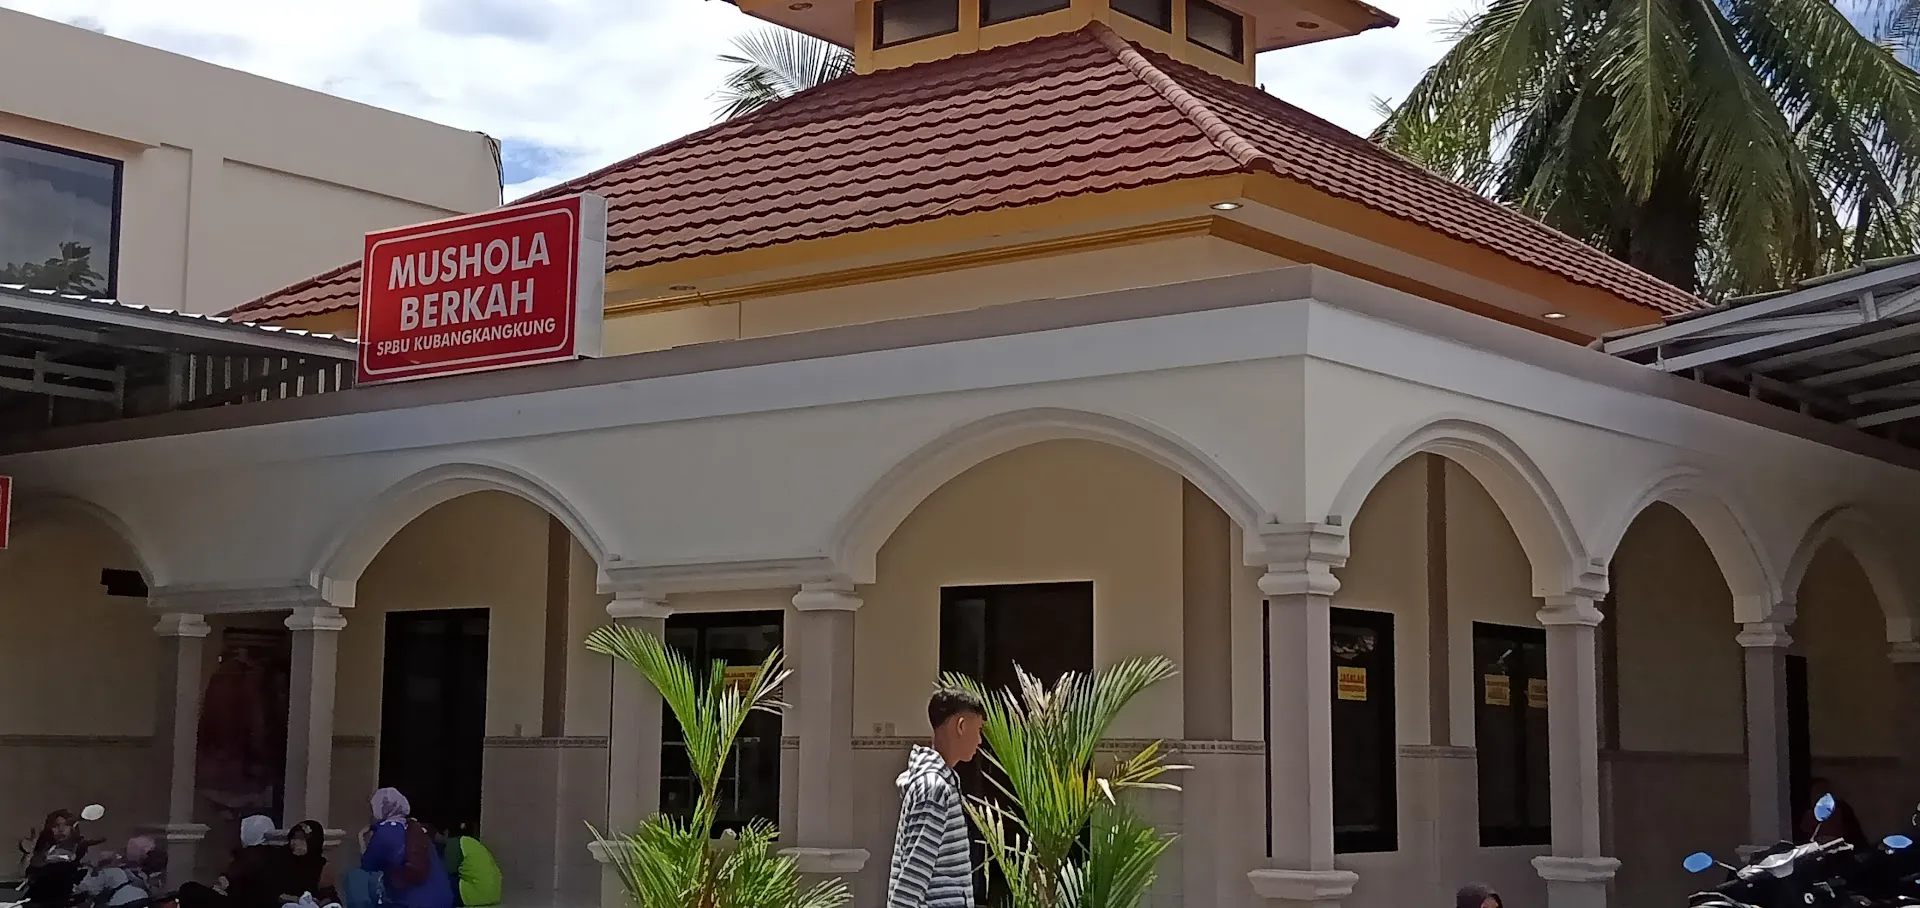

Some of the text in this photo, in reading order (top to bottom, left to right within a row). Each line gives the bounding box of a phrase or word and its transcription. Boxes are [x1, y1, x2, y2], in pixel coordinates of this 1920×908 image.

[388, 231, 550, 291] MUSHOLA
[400, 278, 535, 332] BERKAH
[376, 318, 556, 356] SPBU KUBANGKANGKUNG
